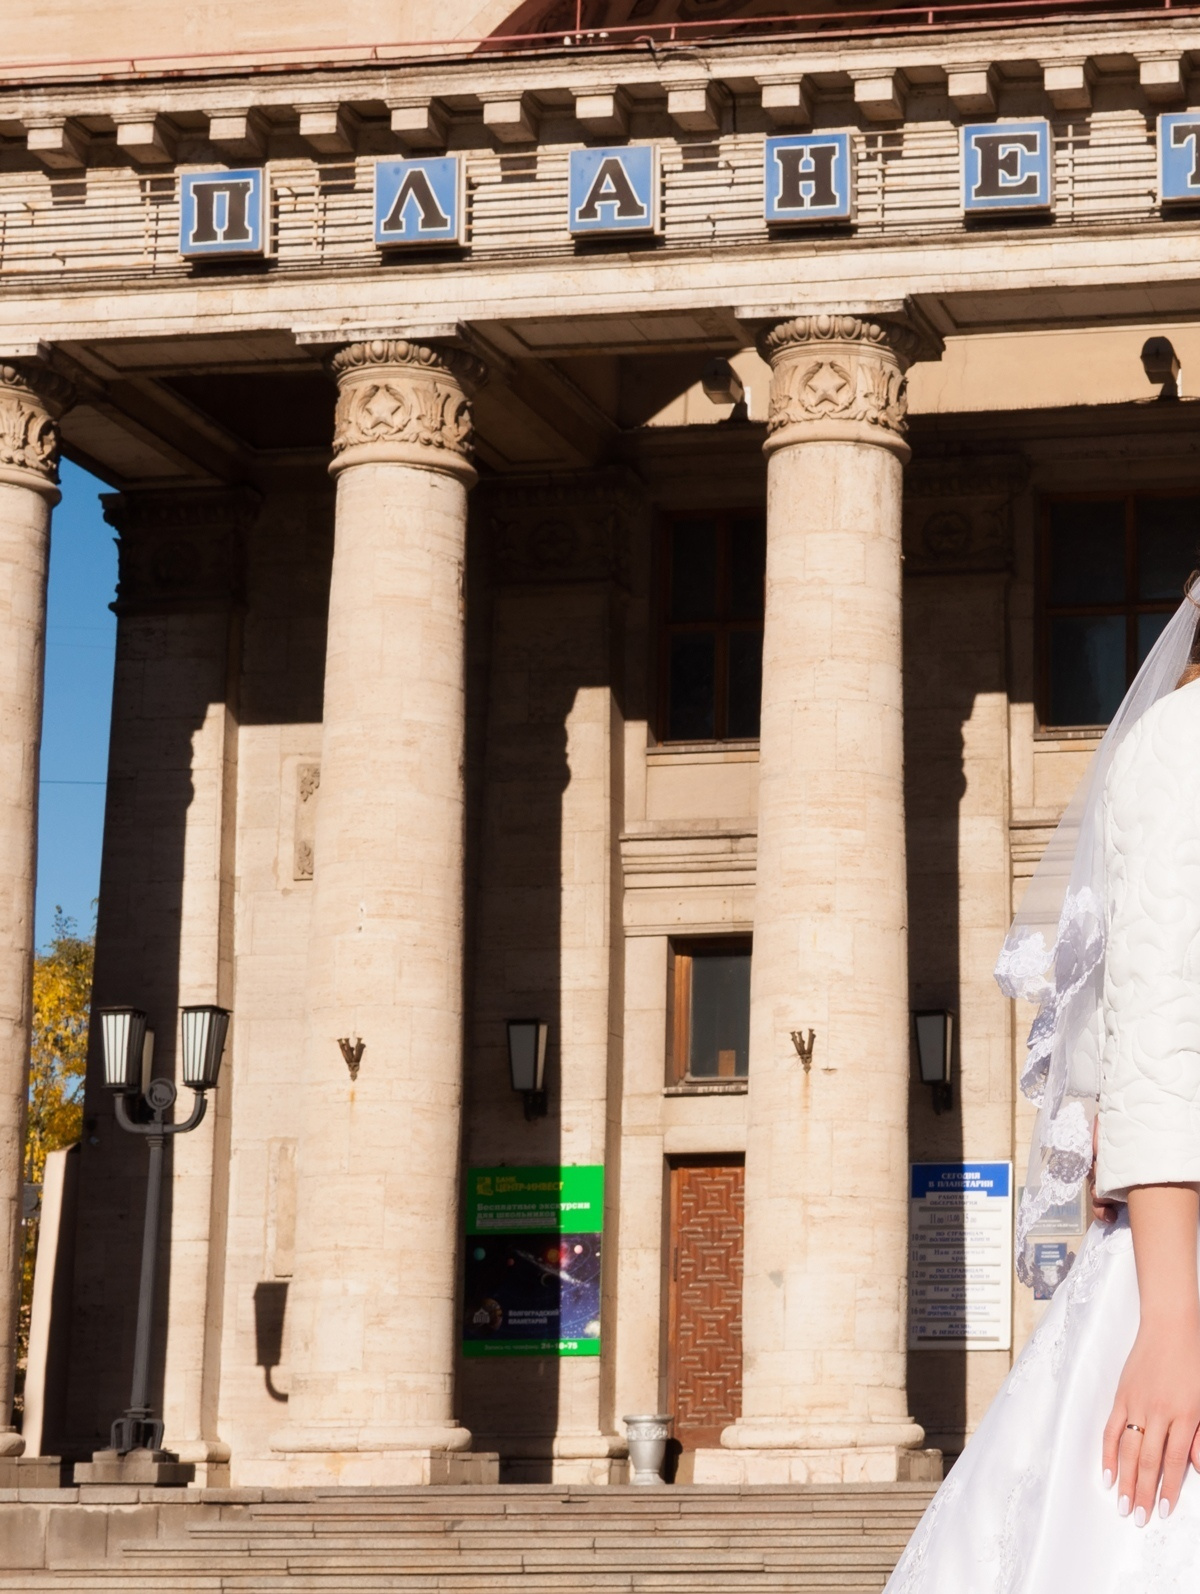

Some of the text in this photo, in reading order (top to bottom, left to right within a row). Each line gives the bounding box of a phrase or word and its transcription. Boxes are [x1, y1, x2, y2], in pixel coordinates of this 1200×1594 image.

[941, 1172, 981, 1180] СЕГОДНЯ
[928, 1180, 935, 1188] В
[477, 1202, 591, 1211] Бесплатные экскурсии
